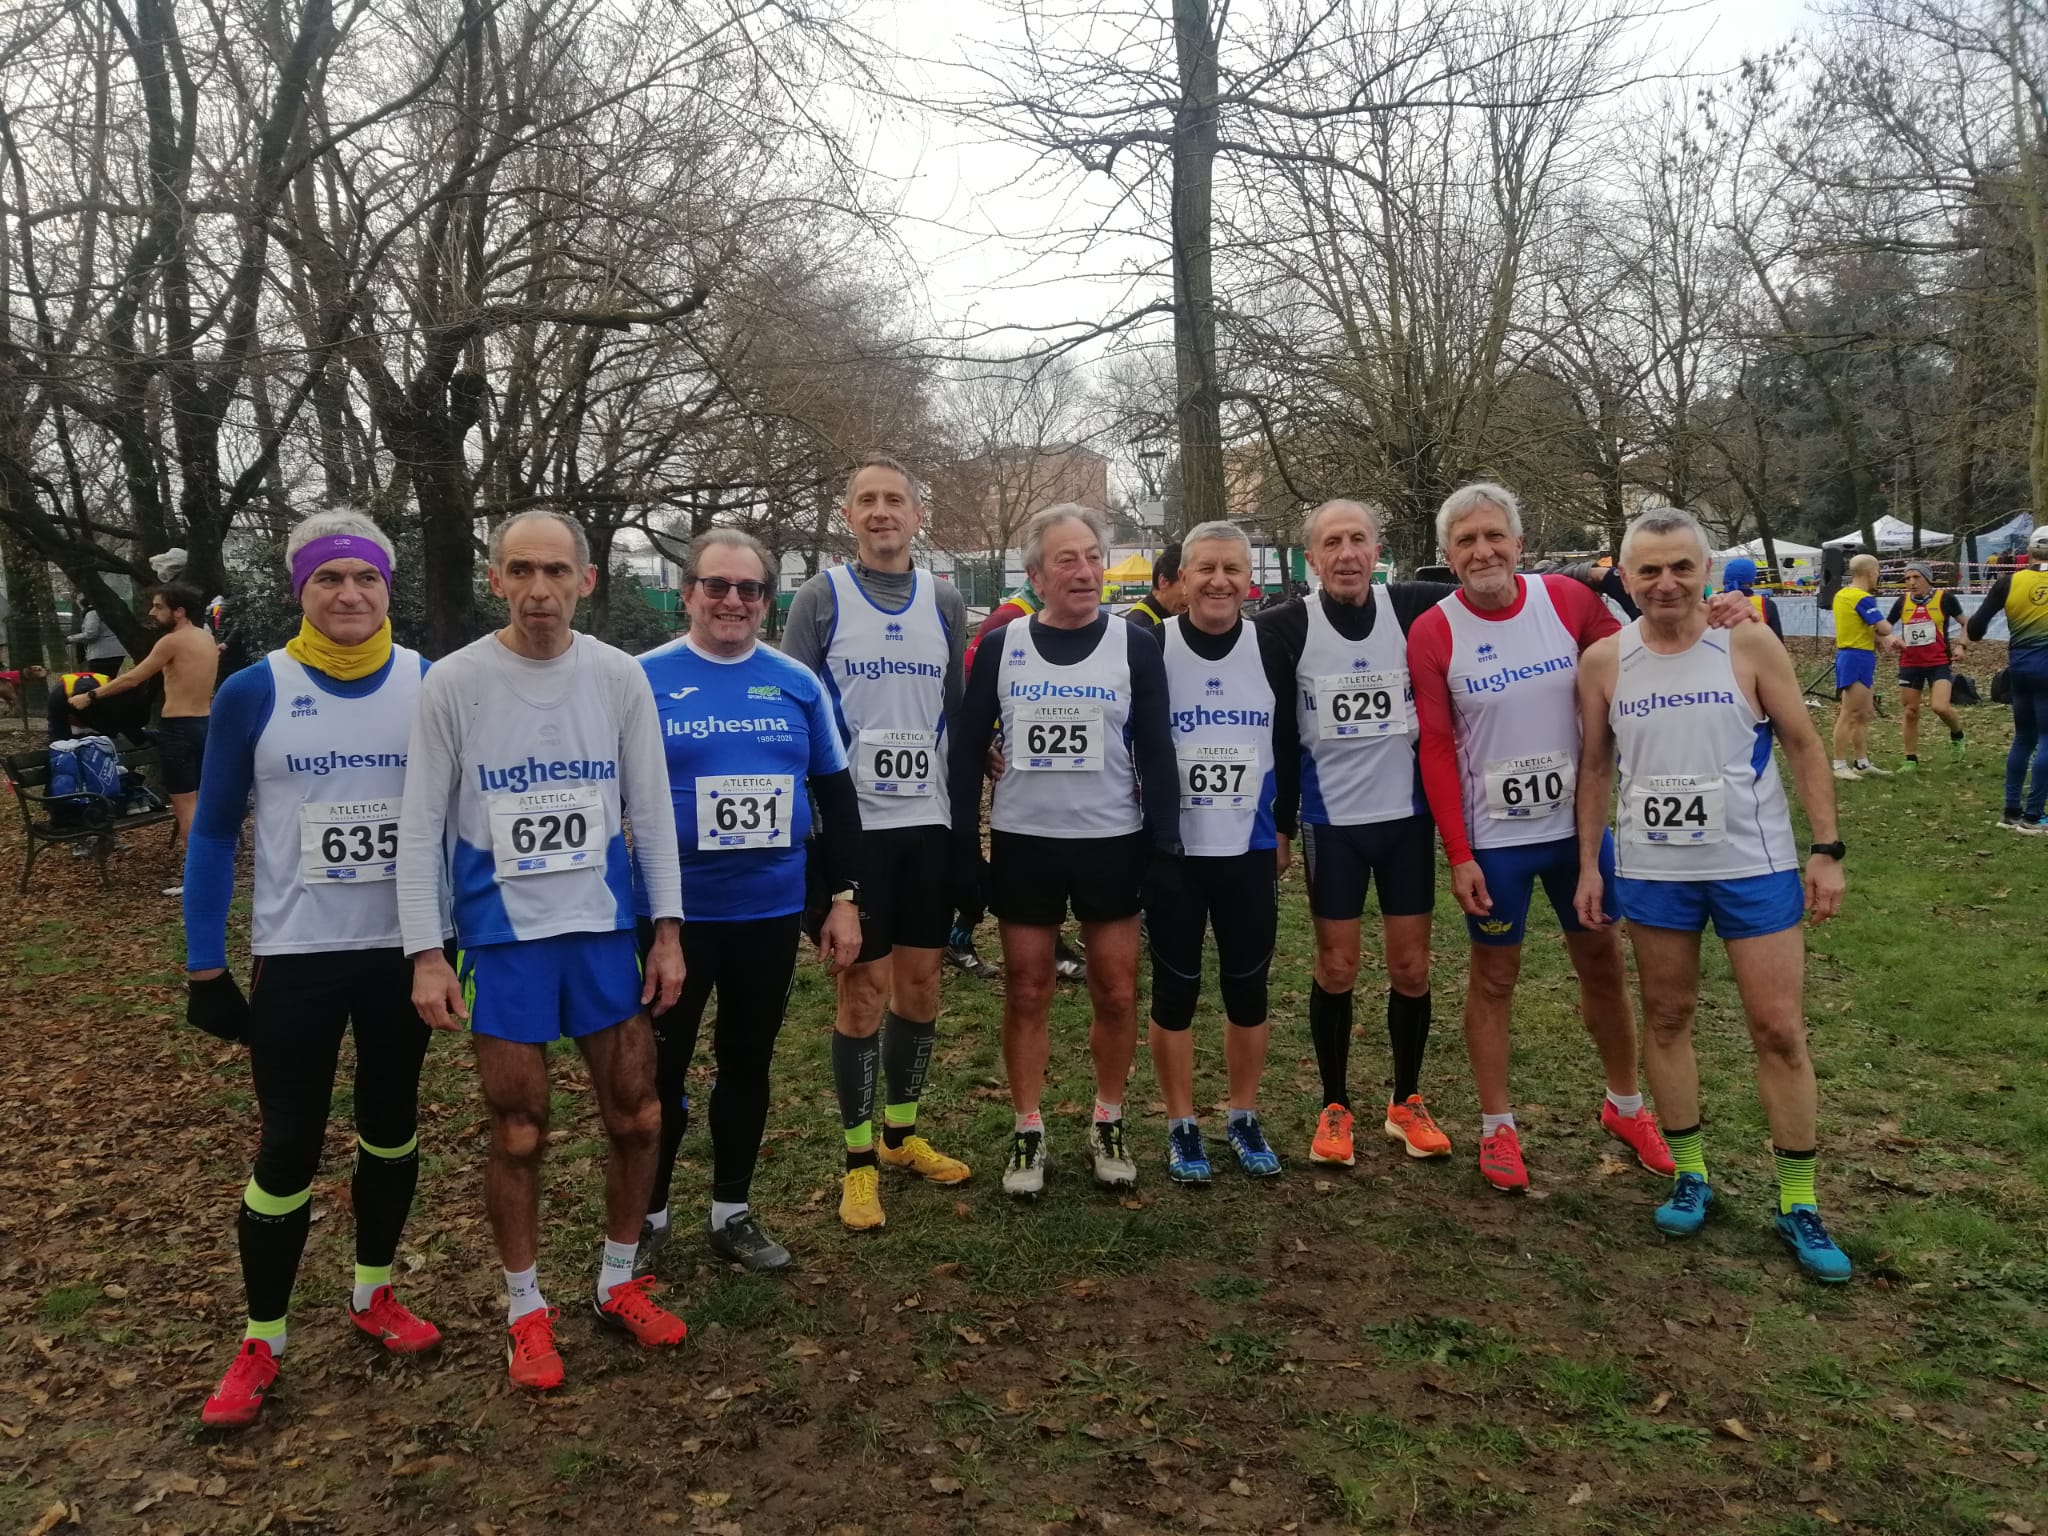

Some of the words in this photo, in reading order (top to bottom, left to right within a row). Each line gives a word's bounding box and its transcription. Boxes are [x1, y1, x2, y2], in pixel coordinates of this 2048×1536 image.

[1911, 630, 1926, 641] 64
[844, 656, 942, 680] lughesina
[1338, 675, 1384, 684] ATLETICA
[1464, 655, 1574, 694] lughesina
[1009, 680, 1117, 702] lughesina
[1618, 690, 1735, 718] lughesina
[1035, 707, 1080, 715] ATLETICA
[1332, 690, 1392, 722] 629
[666, 715, 789, 739] lughesina
[883, 732, 924, 741] ATLETICA
[1027, 724, 1088, 754] 625
[874, 749, 929, 779] 609
[1197, 747, 1239, 755] ATLETICA
[1507, 756, 1553, 769] ATLETICA
[477, 756, 616, 793] lughesina
[723, 778, 773, 787] ATLETICA
[1189, 763, 1246, 793] 637
[1502, 771, 1563, 806] 610
[1650, 778, 1697, 787] ATLETICA
[329, 802, 388, 816] ATLETICA
[518, 792, 576, 806] ATLETICA
[1644, 795, 1708, 827] 624
[716, 796, 777, 831] 631
[321, 822, 398, 864] 635
[511, 812, 587, 854] 620
[904, 1035, 936, 1097] kalenji
[857, 1048, 878, 1118] kalenji
